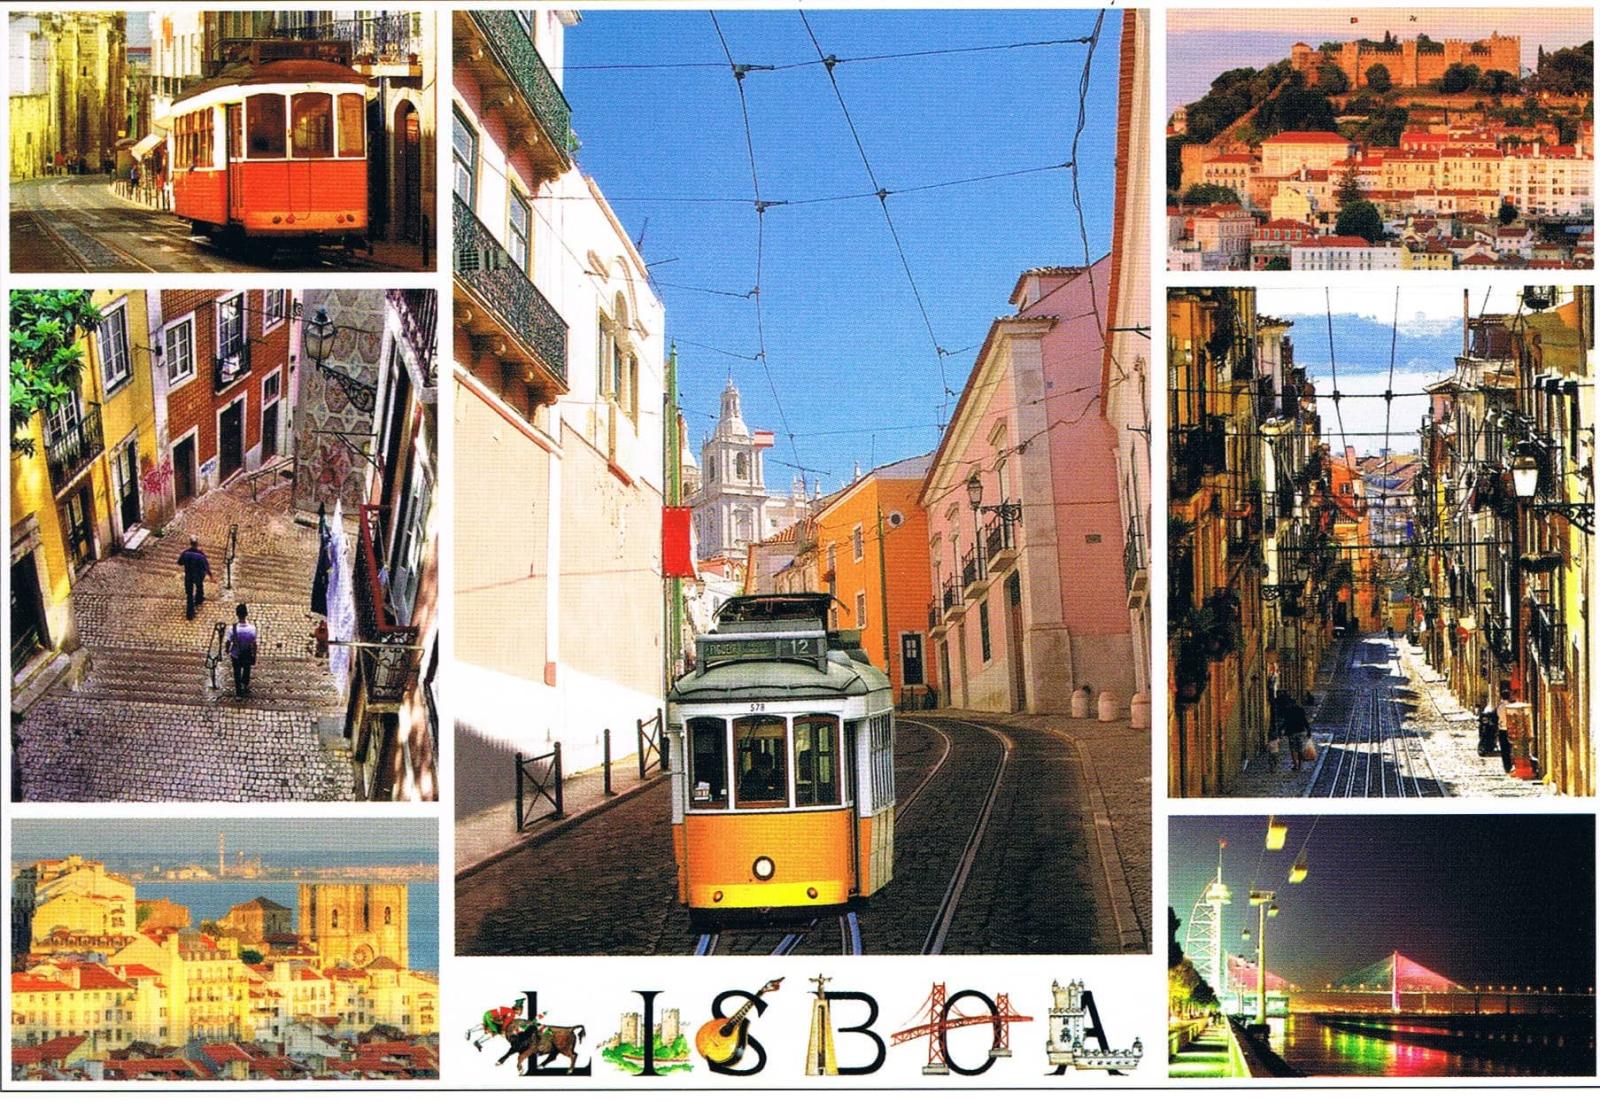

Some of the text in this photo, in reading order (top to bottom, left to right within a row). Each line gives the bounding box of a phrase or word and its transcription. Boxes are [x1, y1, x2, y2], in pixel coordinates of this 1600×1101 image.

[790, 638, 809, 655] 12
[749, 703, 766, 712] 578
[517, 988, 1129, 1077] LISBOA
